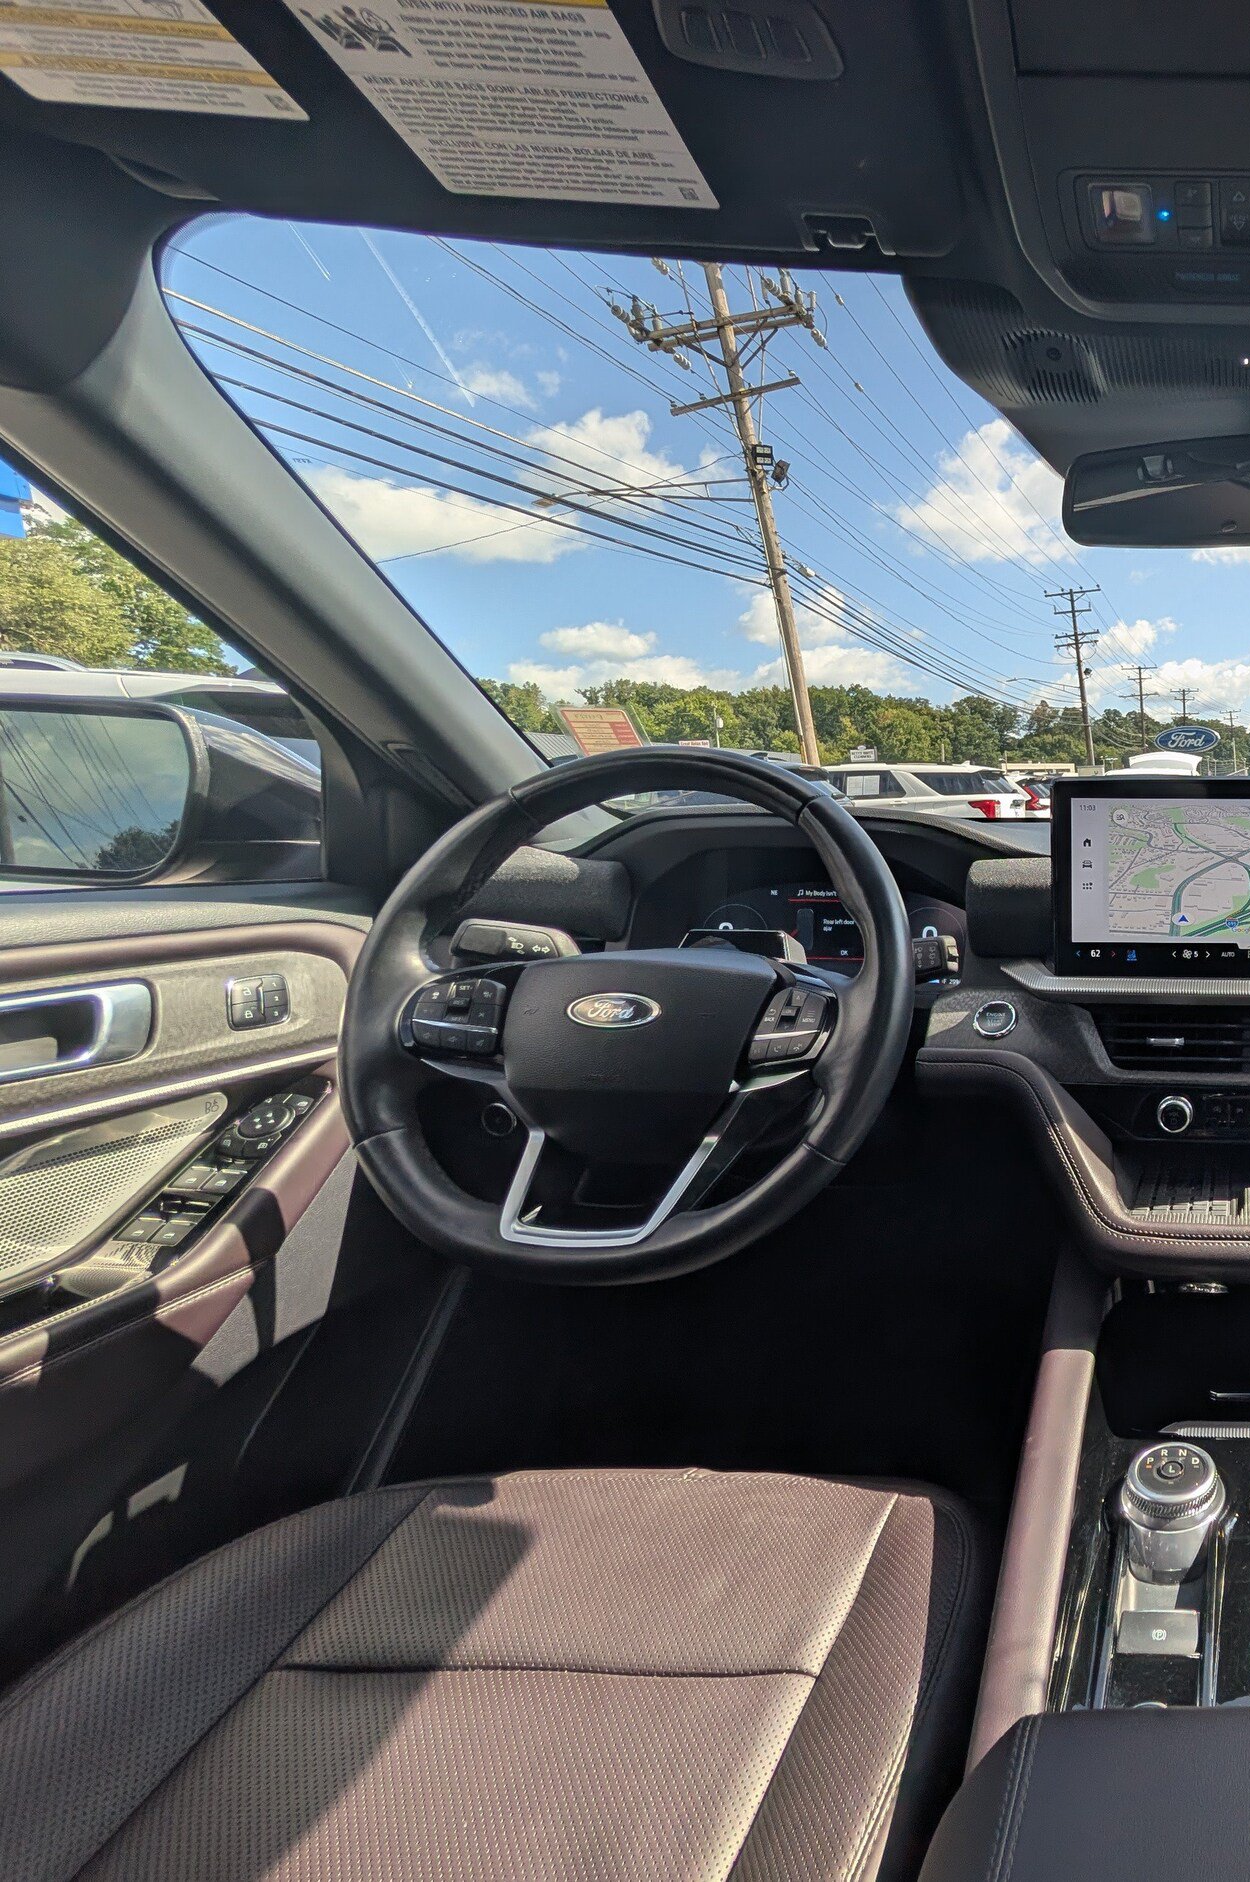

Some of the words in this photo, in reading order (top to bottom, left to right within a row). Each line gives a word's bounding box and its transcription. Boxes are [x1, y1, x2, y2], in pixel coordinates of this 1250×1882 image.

[433, 0, 462, 12] WITH
[464, 3, 527, 19] ADVANCED
[529, 9, 550, 20] AIR
[428, 137, 483, 151] INCLUSIVE
[484, 140, 509, 152] CON
[509, 141, 531, 153] LAS
[530, 143, 573, 156] NUEVAS
[573, 146, 616, 158] BOLSAS
[616, 149, 631, 159] DE
[631, 149, 657, 161] AIRE
[770, 889, 779, 897] NE
[805, 889, 813, 897] My
[813, 889, 826, 898] Body
[1090, 949, 1101, 958] 62
[587, 999, 637, 1019] Ford
[1160, 1449, 1168, 1457] R
[1178, 1449, 1187, 1457] N
[1191, 1457, 1200, 1465] D
[1169, 1465, 1176, 1473] L
